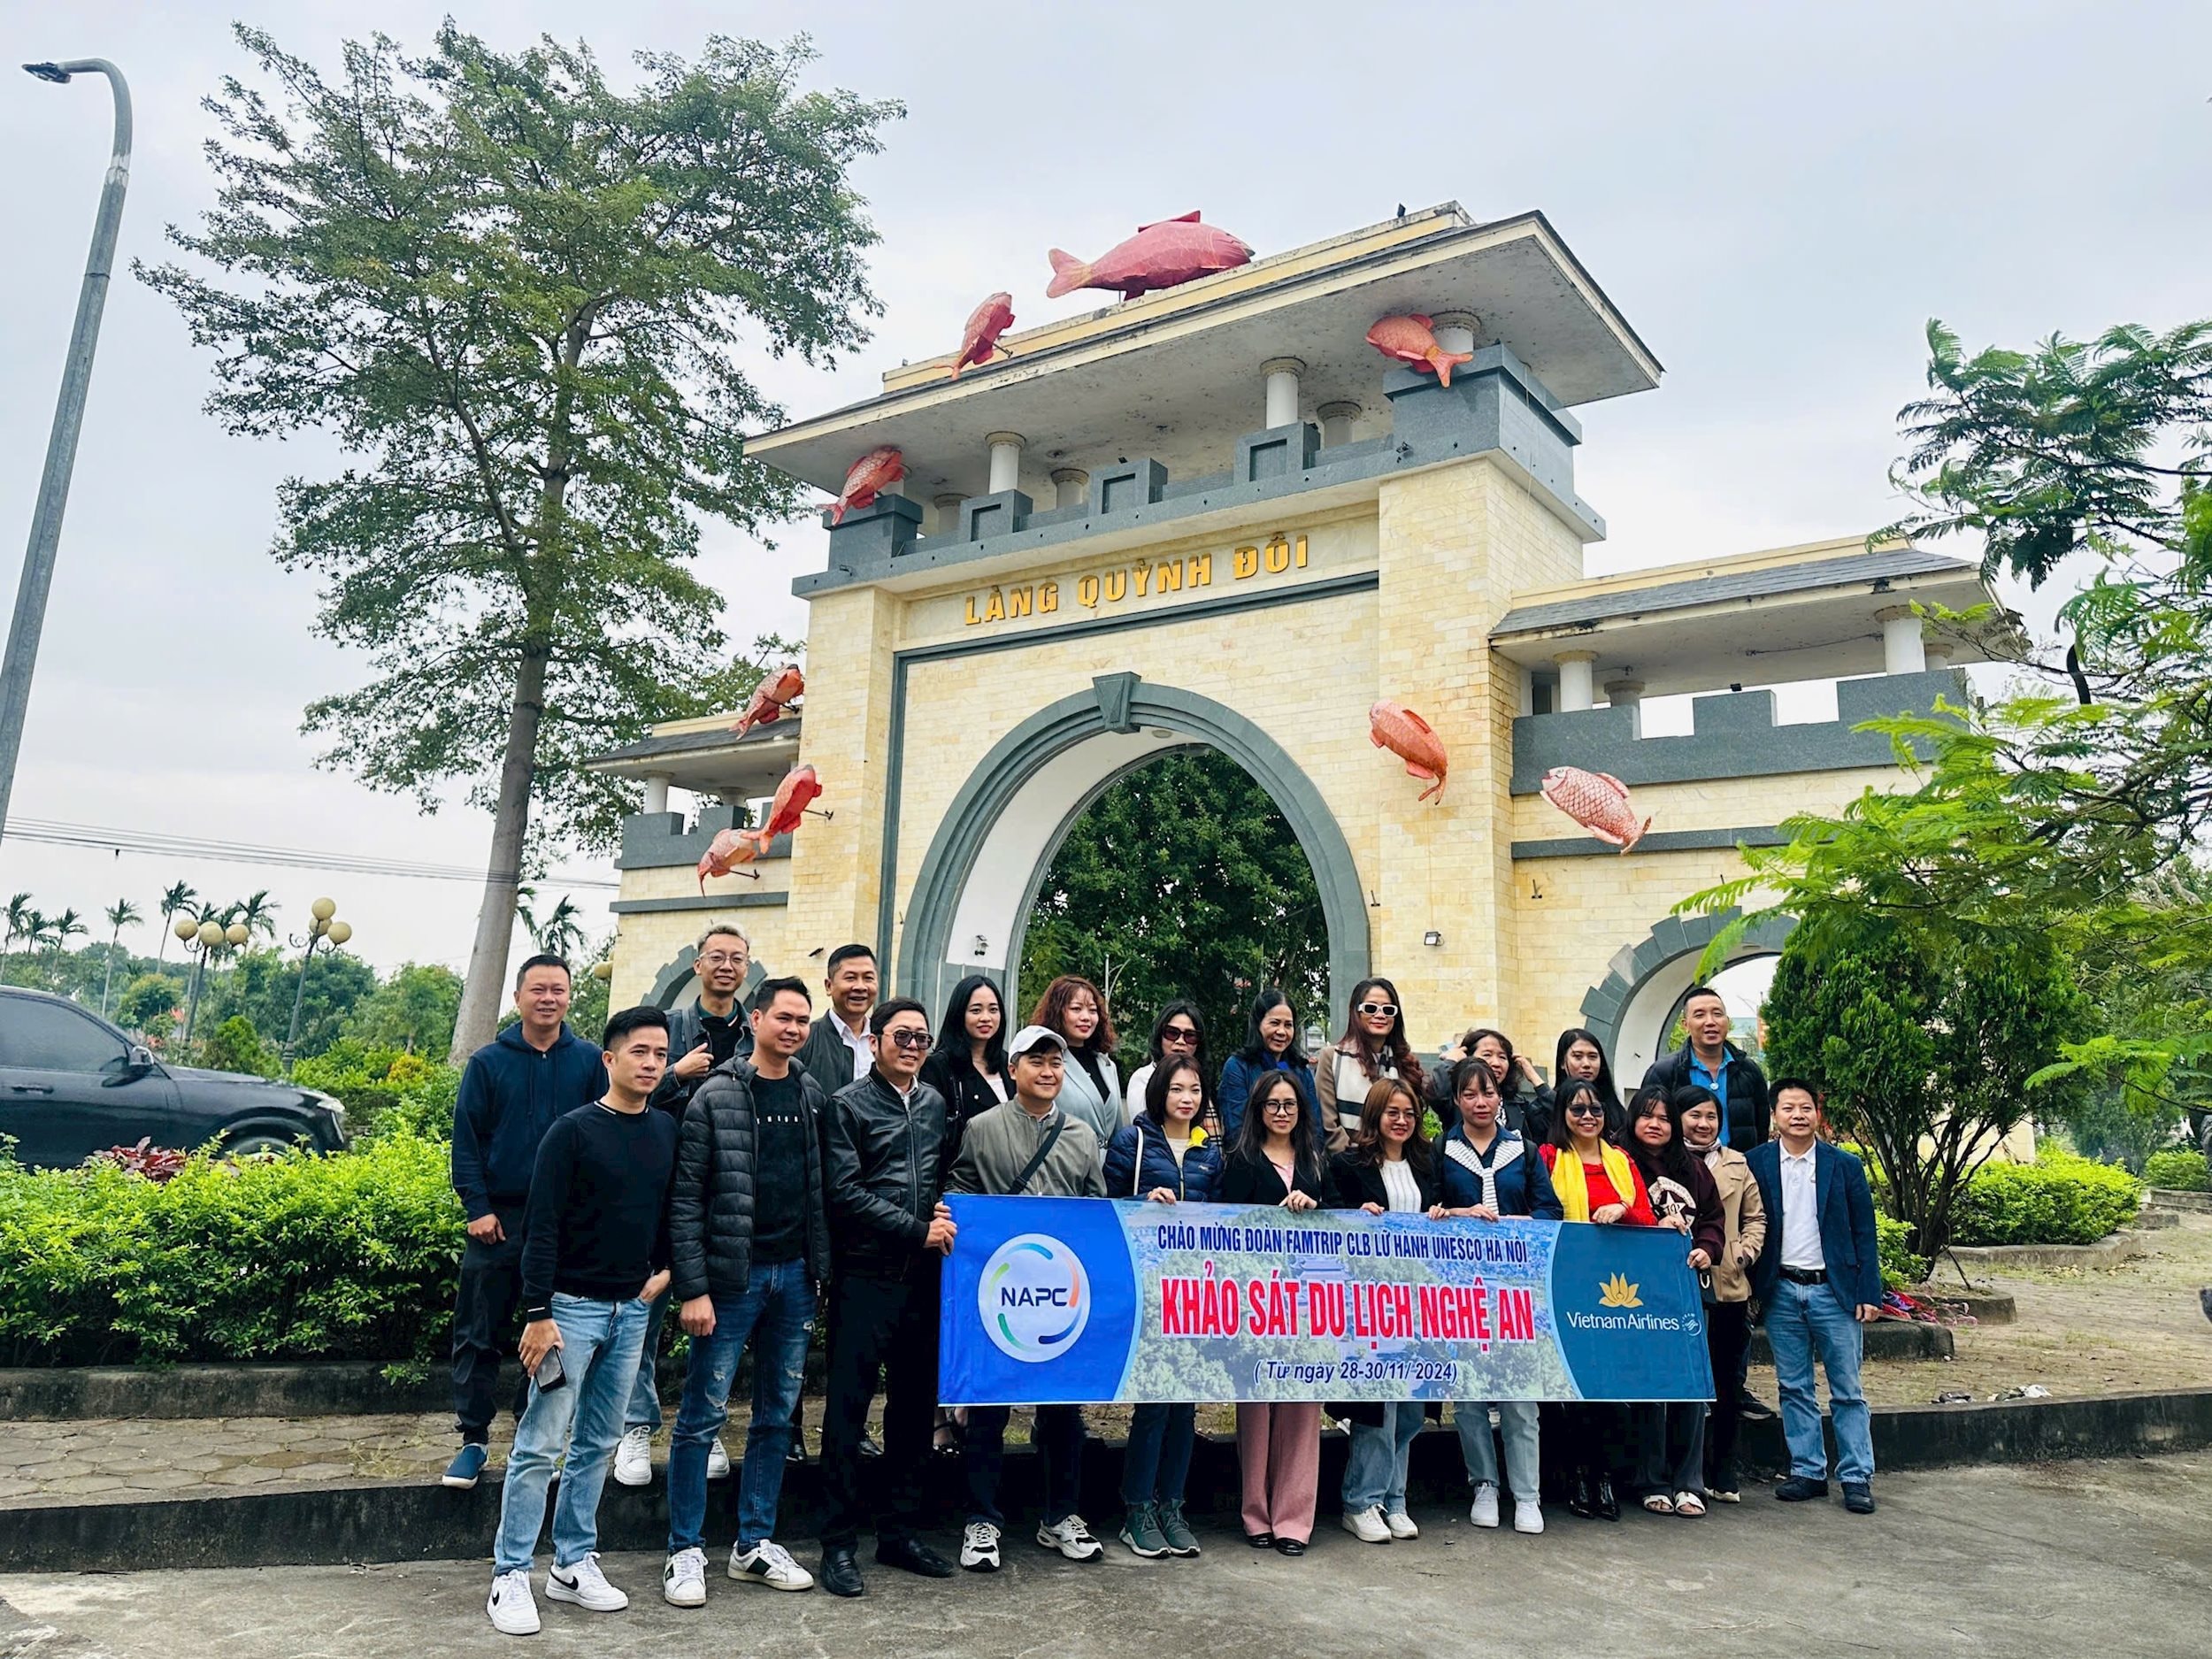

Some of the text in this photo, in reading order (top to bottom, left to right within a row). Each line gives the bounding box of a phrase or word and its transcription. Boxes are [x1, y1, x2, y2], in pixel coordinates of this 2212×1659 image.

[965, 582, 1058, 626] LÀNG
[1077, 553, 1212, 609] QUỲNH
[1157, 1221, 1527, 1267] CHÀO MỪNG ĐOÀN FAMTRIP CLB LỮ HÀNH UNESCO HÀ NỘI
[1001, 1286, 1067, 1307] NAPC
[1161, 1260, 1535, 1351] KHẢO SÁT DU LỊCH NGHỆ AN
[1566, 1311, 1626, 1329] Vietnam
[1627, 1313, 1679, 1331] Airlines
[1294, 1360, 1334, 1383] ngày
